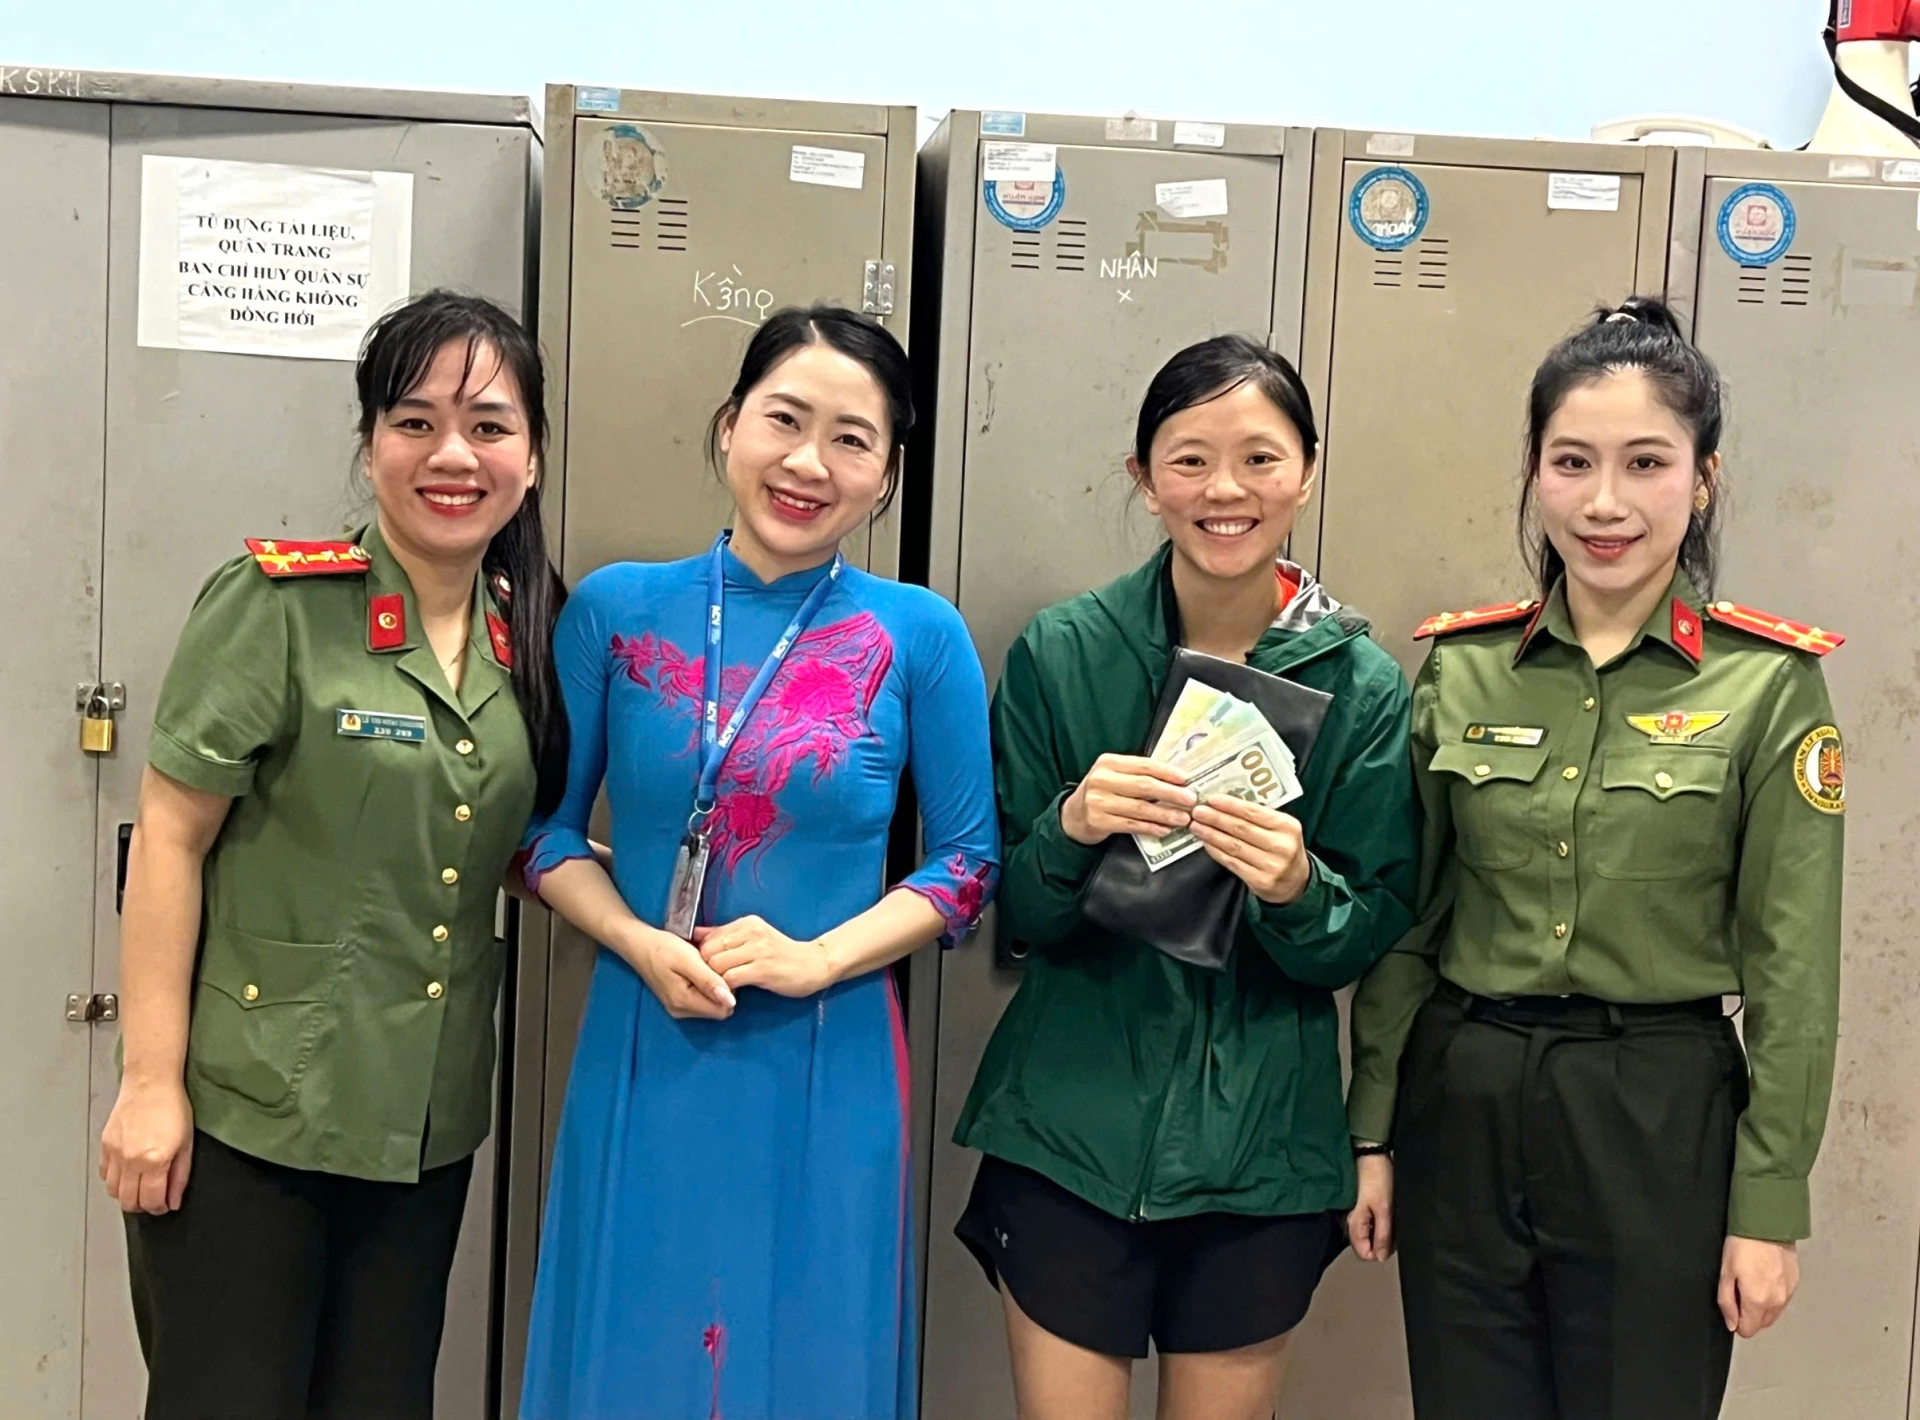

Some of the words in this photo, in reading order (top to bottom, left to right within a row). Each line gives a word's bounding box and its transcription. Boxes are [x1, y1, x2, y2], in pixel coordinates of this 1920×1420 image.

[277, 219, 306, 236] TÀI
[218, 237, 267, 255] QUÂN
[271, 242, 331, 260] TRANG
[179, 261, 213, 275] BAN
[253, 266, 290, 281] HUY
[294, 269, 342, 286] QUÂN
[1100, 250, 1158, 279] NHÂN
[242, 285, 291, 303] HÀNG
[295, 289, 359, 308] KHÔNG
[1240, 750, 1280, 800] 100
